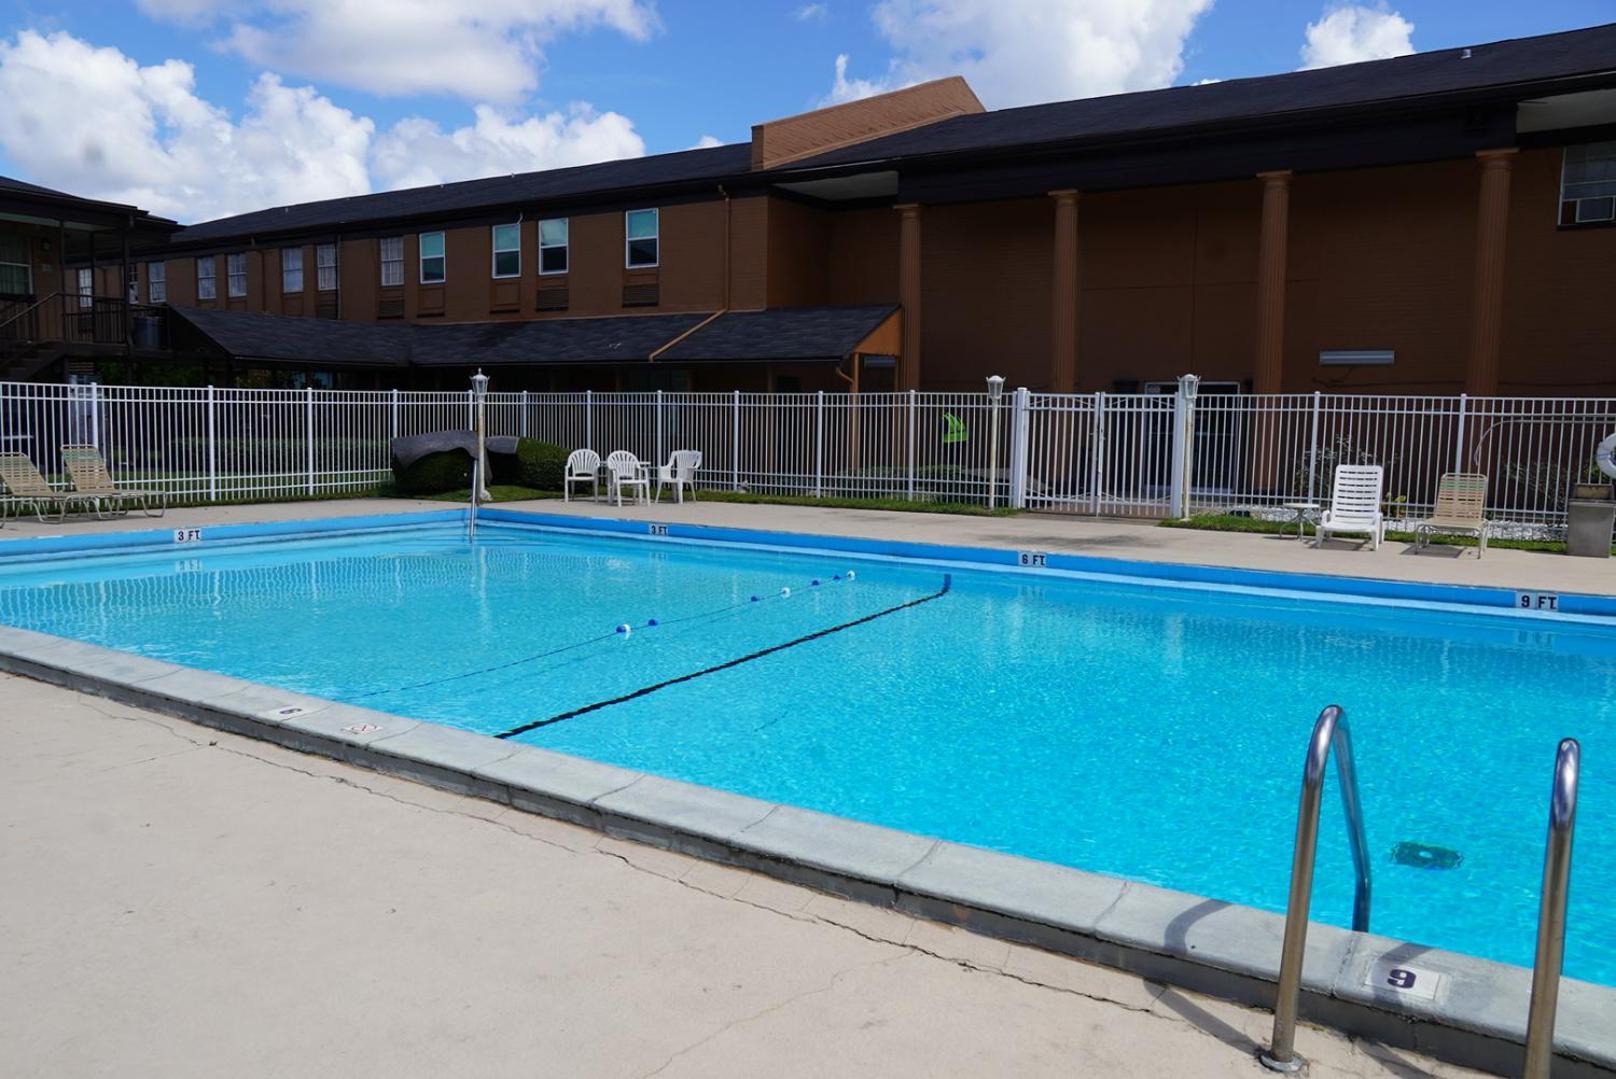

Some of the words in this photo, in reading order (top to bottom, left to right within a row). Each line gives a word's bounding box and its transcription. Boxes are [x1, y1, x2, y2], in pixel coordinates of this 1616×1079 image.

[178, 530, 184, 541] 3
[188, 530, 200, 540] FT
[1521, 595, 1530, 608] 9
[1387, 969, 1417, 989] 9
